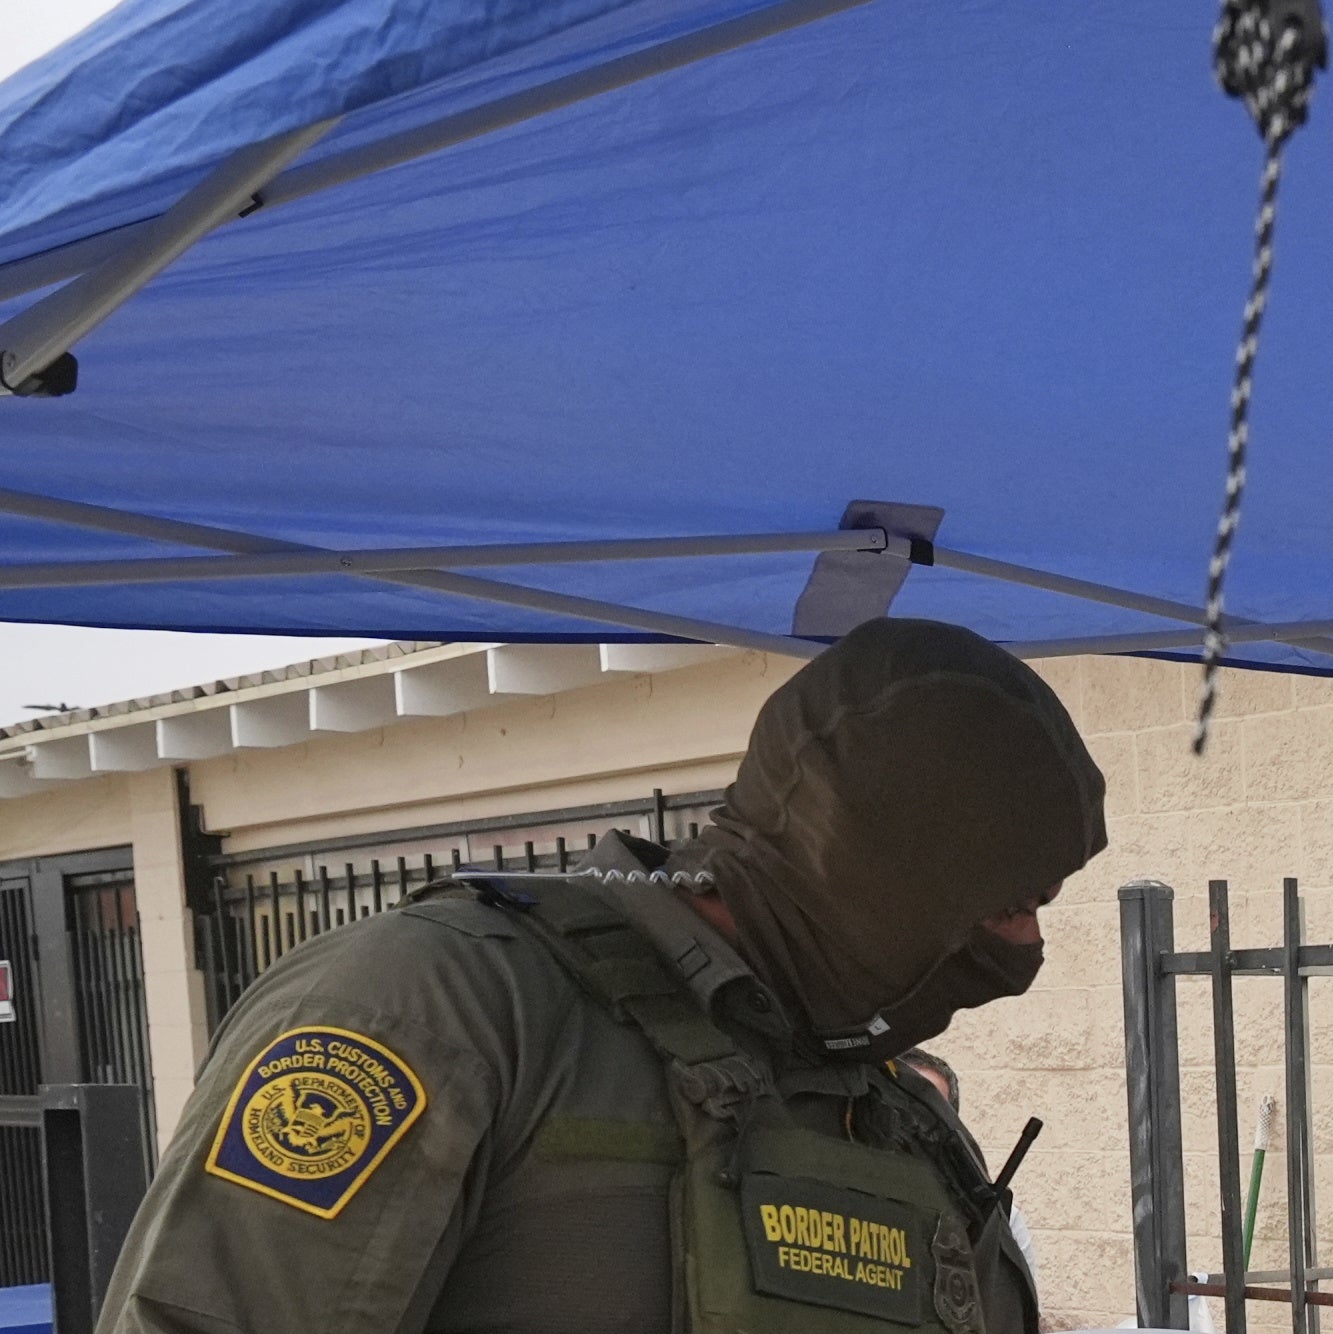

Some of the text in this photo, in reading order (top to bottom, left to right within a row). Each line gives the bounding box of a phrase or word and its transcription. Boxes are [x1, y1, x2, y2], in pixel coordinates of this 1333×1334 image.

[258, 1054, 393, 1126] BORDER PROTECTION
[295, 1038, 408, 1110] U.S. CUSTOMS AND
[248, 1108, 356, 1174] HOMELAND SECURITY
[760, 1204, 911, 1268] BORDER PATROL
[778, 1246, 904, 1291] FEDERAL AGENT
